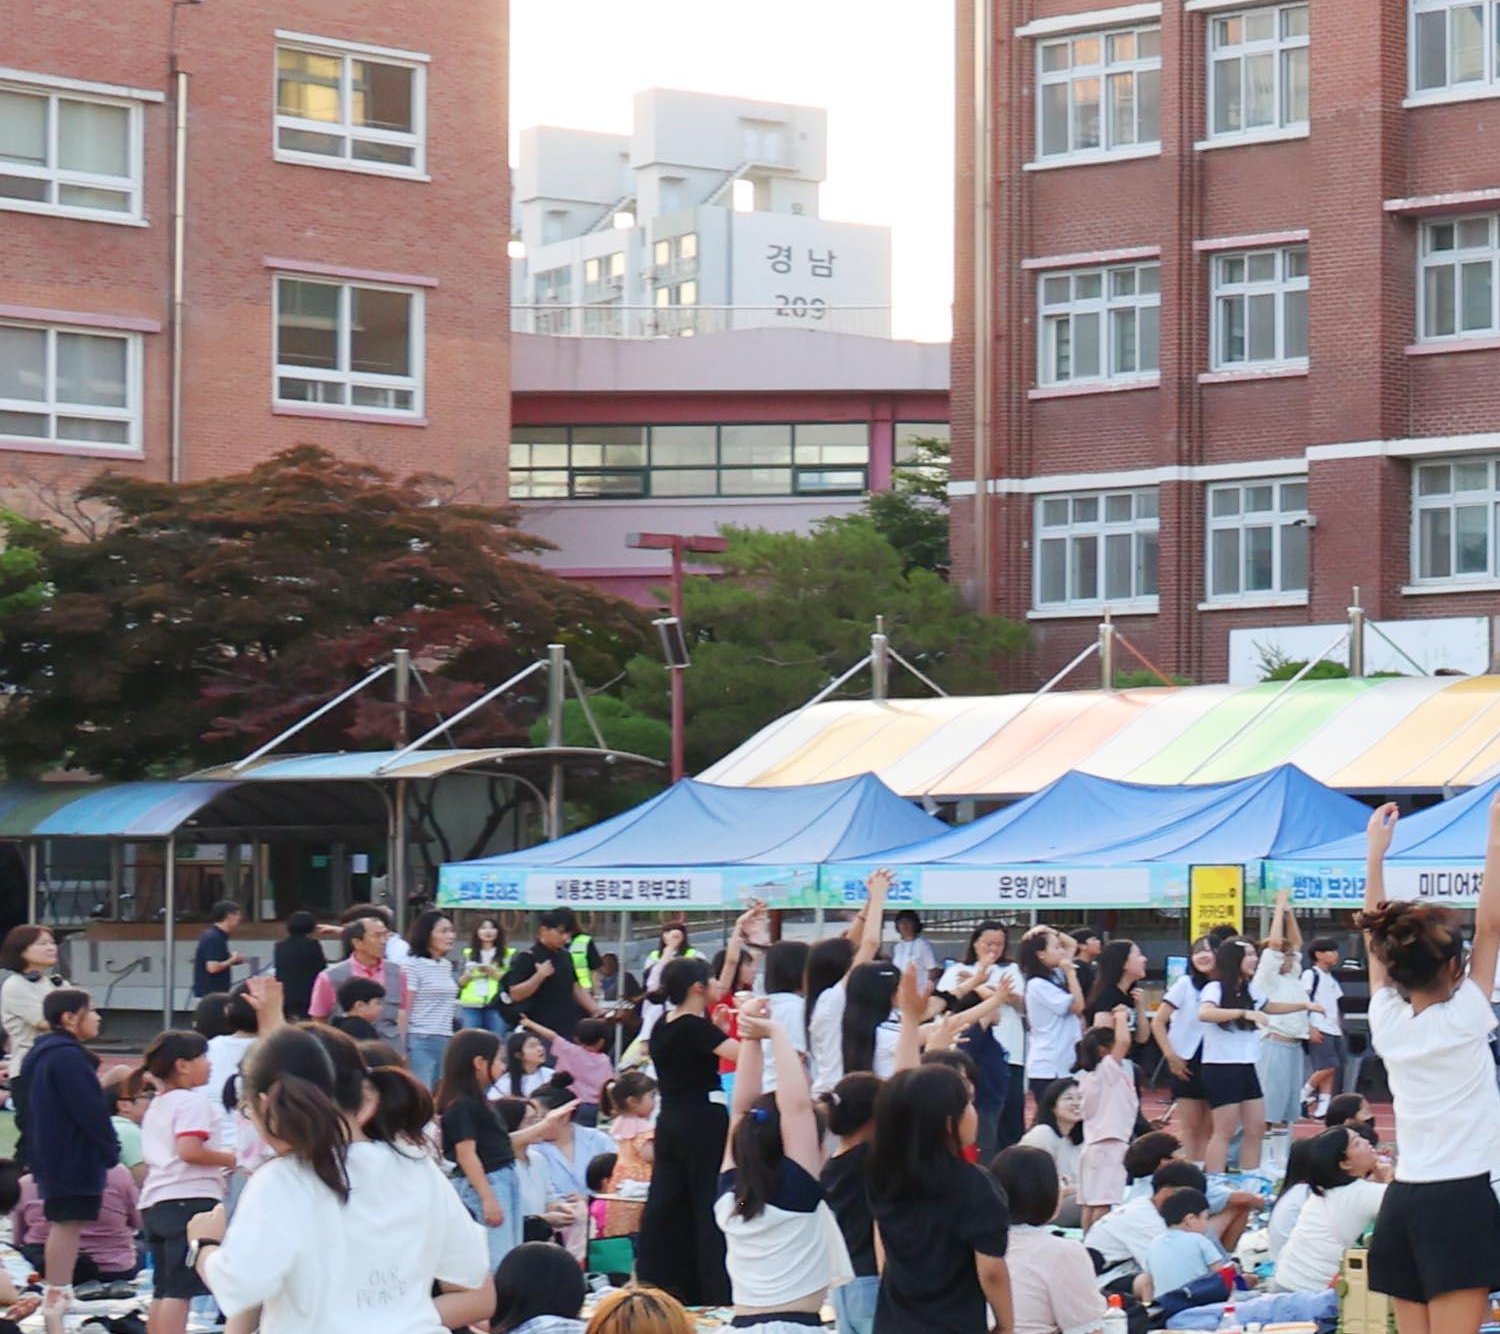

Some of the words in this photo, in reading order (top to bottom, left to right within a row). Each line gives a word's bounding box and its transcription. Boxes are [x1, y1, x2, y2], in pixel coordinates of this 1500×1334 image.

[556, 878, 633, 900] 비룡초등학교
[638, 878, 691, 900] 학부모회
[1000, 875, 1068, 899] 운영/안내
